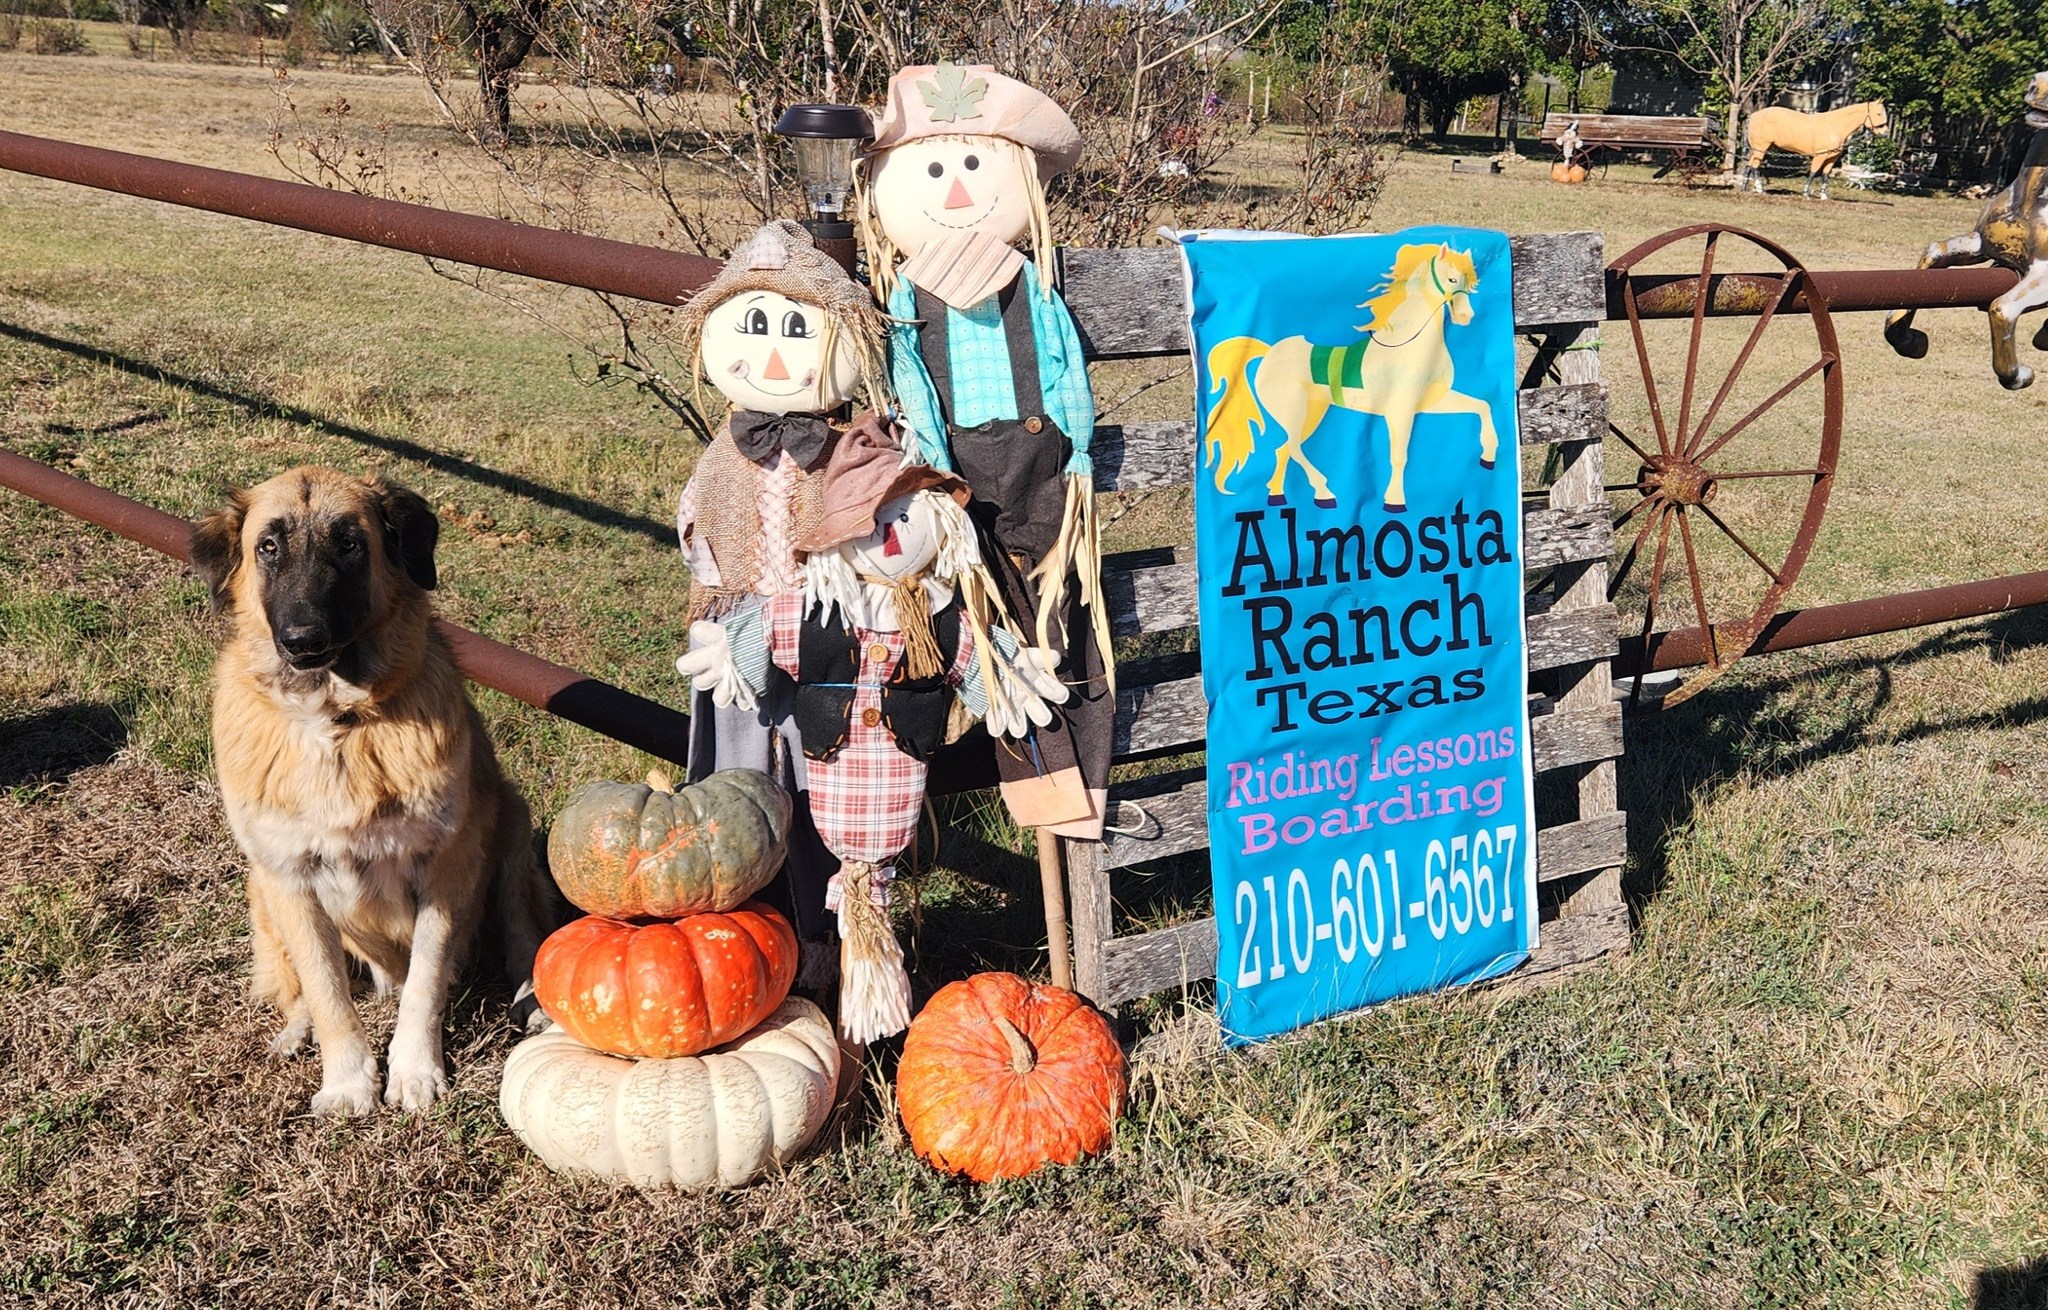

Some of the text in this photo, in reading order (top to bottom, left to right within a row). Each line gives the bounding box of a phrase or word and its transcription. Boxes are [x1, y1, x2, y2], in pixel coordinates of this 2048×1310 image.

[1221, 497, 1512, 597] Almosta
[1243, 573, 1492, 682] Ranch
[1256, 667, 1485, 733] Texas
[1225, 726, 1515, 808] Riding Lessons
[1238, 776, 1507, 855] Boarding
[1235, 824, 1517, 989] 210-601-6567
